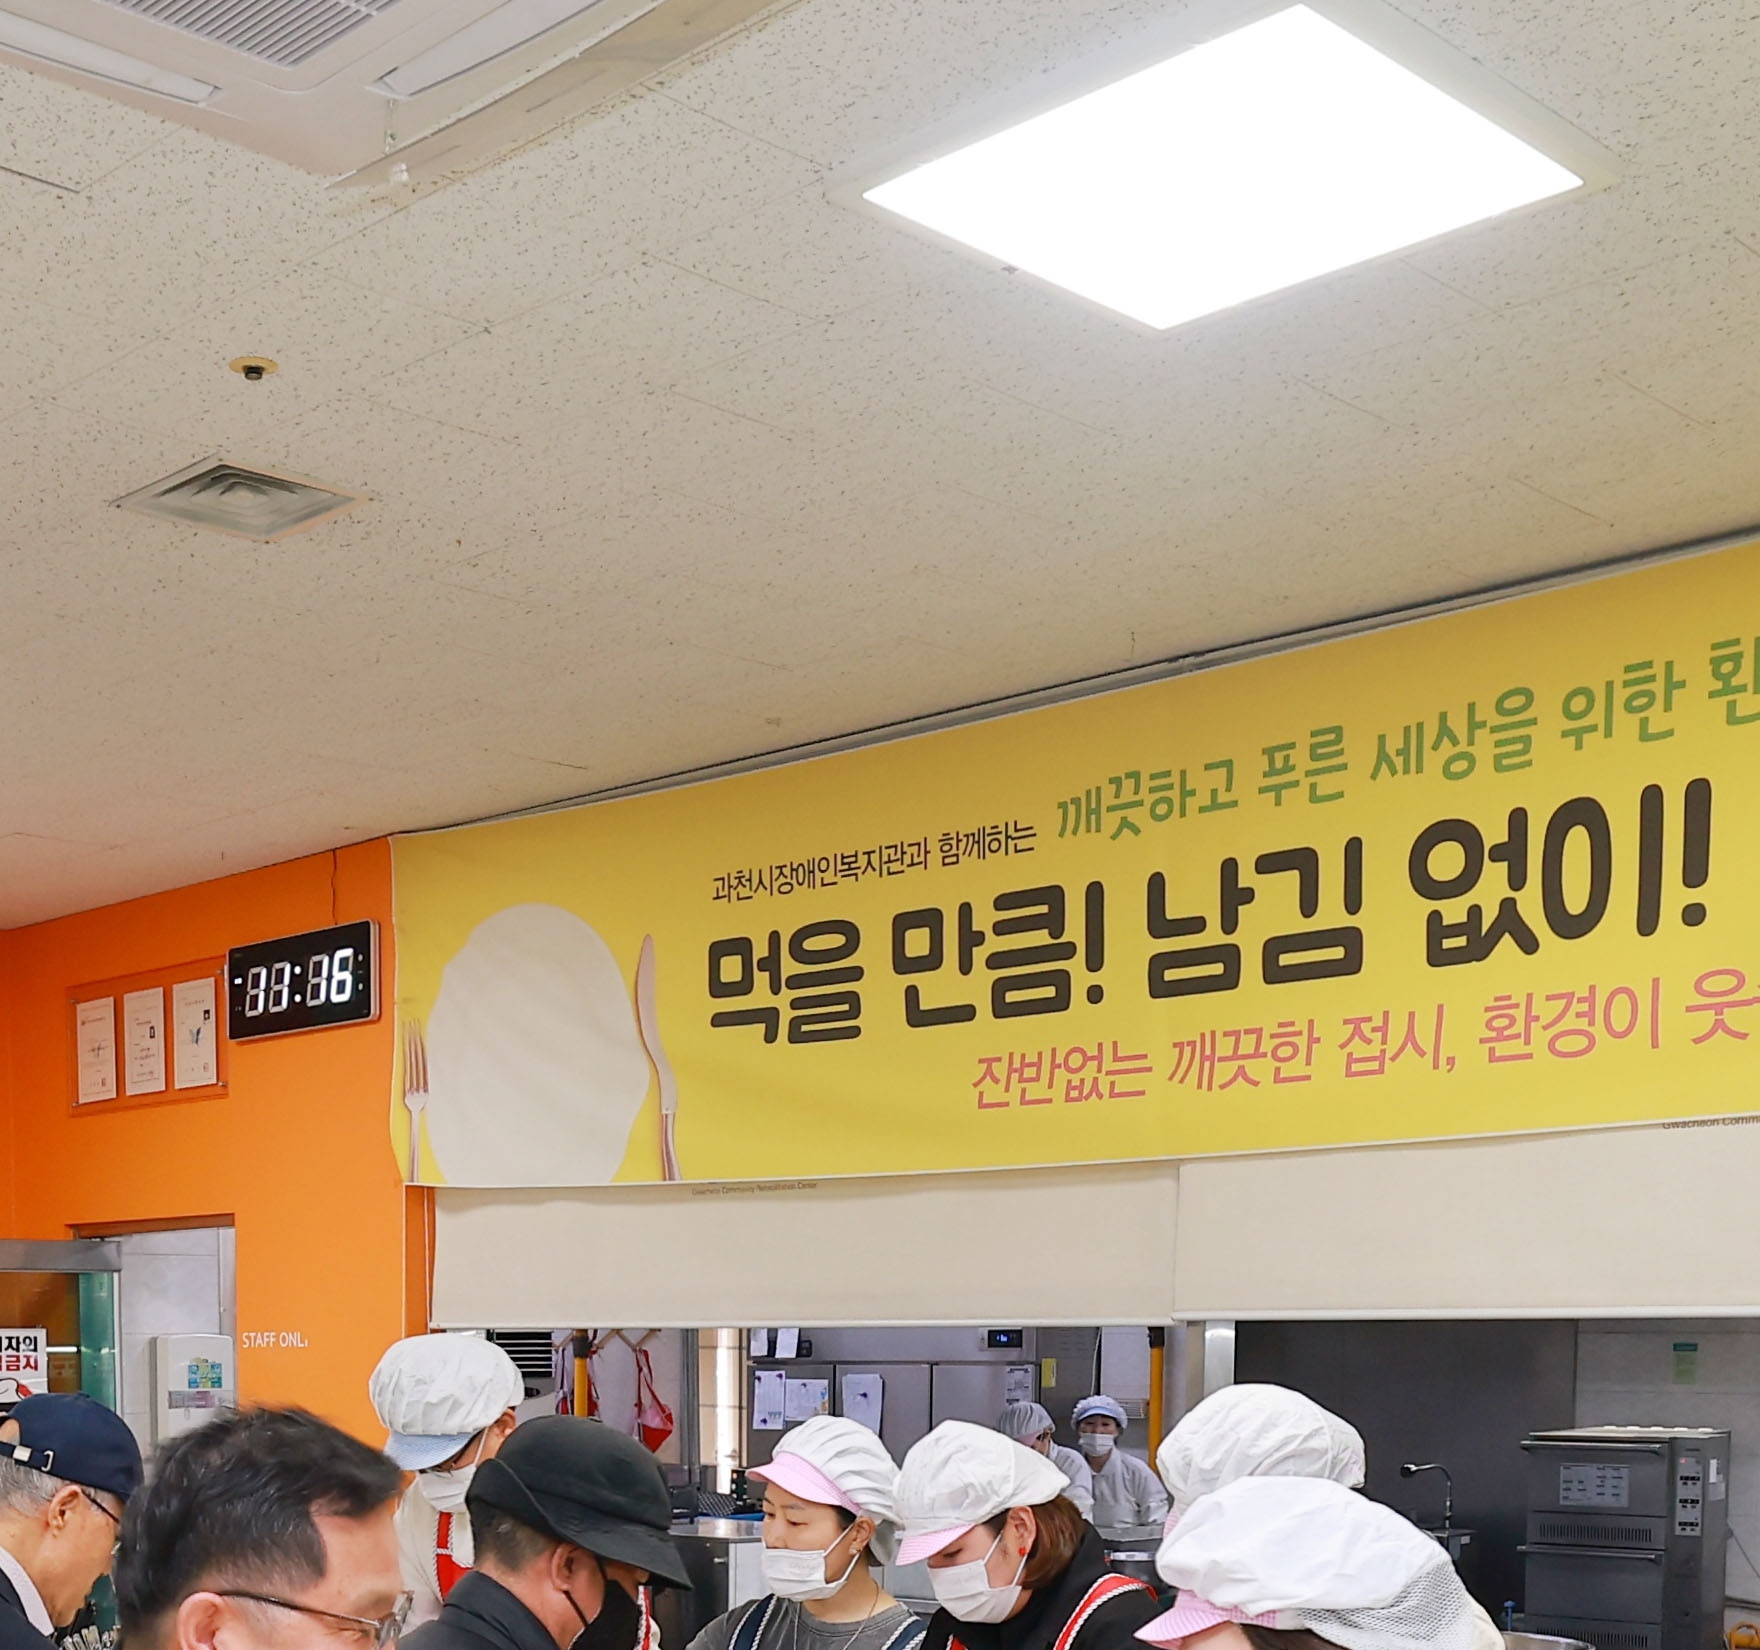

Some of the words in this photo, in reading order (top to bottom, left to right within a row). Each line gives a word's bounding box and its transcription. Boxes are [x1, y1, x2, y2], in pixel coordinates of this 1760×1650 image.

[1056, 757, 1239, 842] 깨끗하고
[1257, 724, 1349, 809] 푸른
[1369, 685, 1540, 782] 세상을
[1560, 658, 1687, 752] 위한
[707, 919, 865, 1045] 먹을
[891, 880, 1107, 1029] 만큼!
[1146, 836, 1365, 1000] 남김
[1408, 776, 1713, 969] 없이!
[711, 836, 932, 904] 과천시장애인복지관과
[938, 819, 1038, 868] 함께하는
[245, 947, 354, 1018] 11:16
[971, 1040, 1154, 1111] 잔반없는
[1168, 1018, 1323, 1093] 깨끗한
[1338, 1003, 1457, 1079] 접시,
[1478, 976, 1663, 1064] 환경이
[242, 1332, 276, 1348] STAFF
